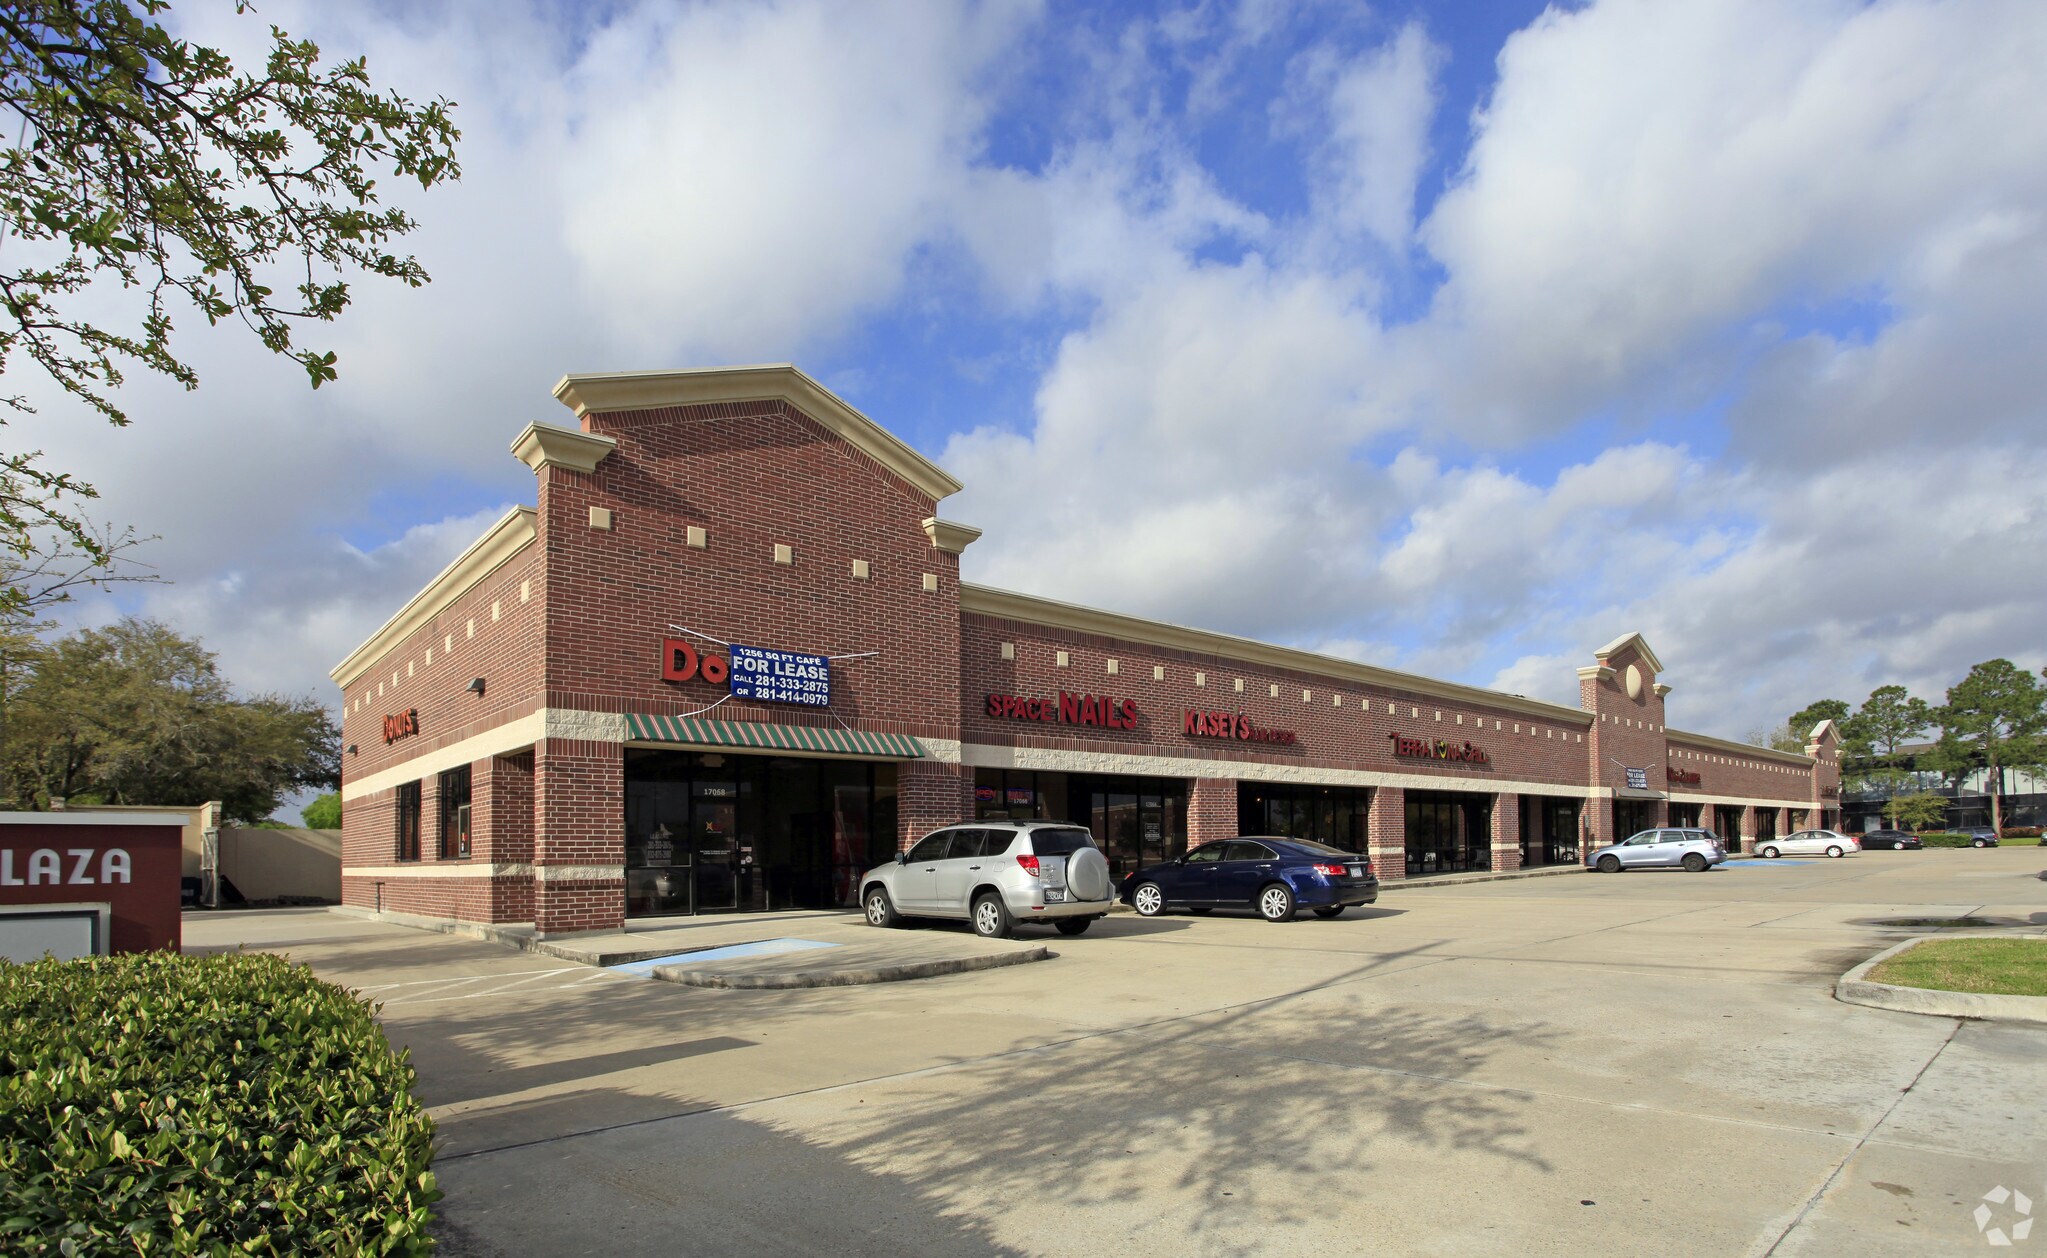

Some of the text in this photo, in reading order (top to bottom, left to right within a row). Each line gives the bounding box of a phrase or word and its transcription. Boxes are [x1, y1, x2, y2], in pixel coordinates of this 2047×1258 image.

[739, 648, 763, 658] 1256
[765, 651, 780, 661] SQ
[781, 654, 794, 662] FT
[733, 656, 828, 681] FOR LEASE
[733, 674, 829, 693] CALL 281-333-2875
[736, 687, 828, 706] OR 281-414-0979
[988, 690, 1138, 730] SPACE NAILS
[1183, 706, 1249, 740] KASEY'S
[0, 848, 131, 886] LAZA
